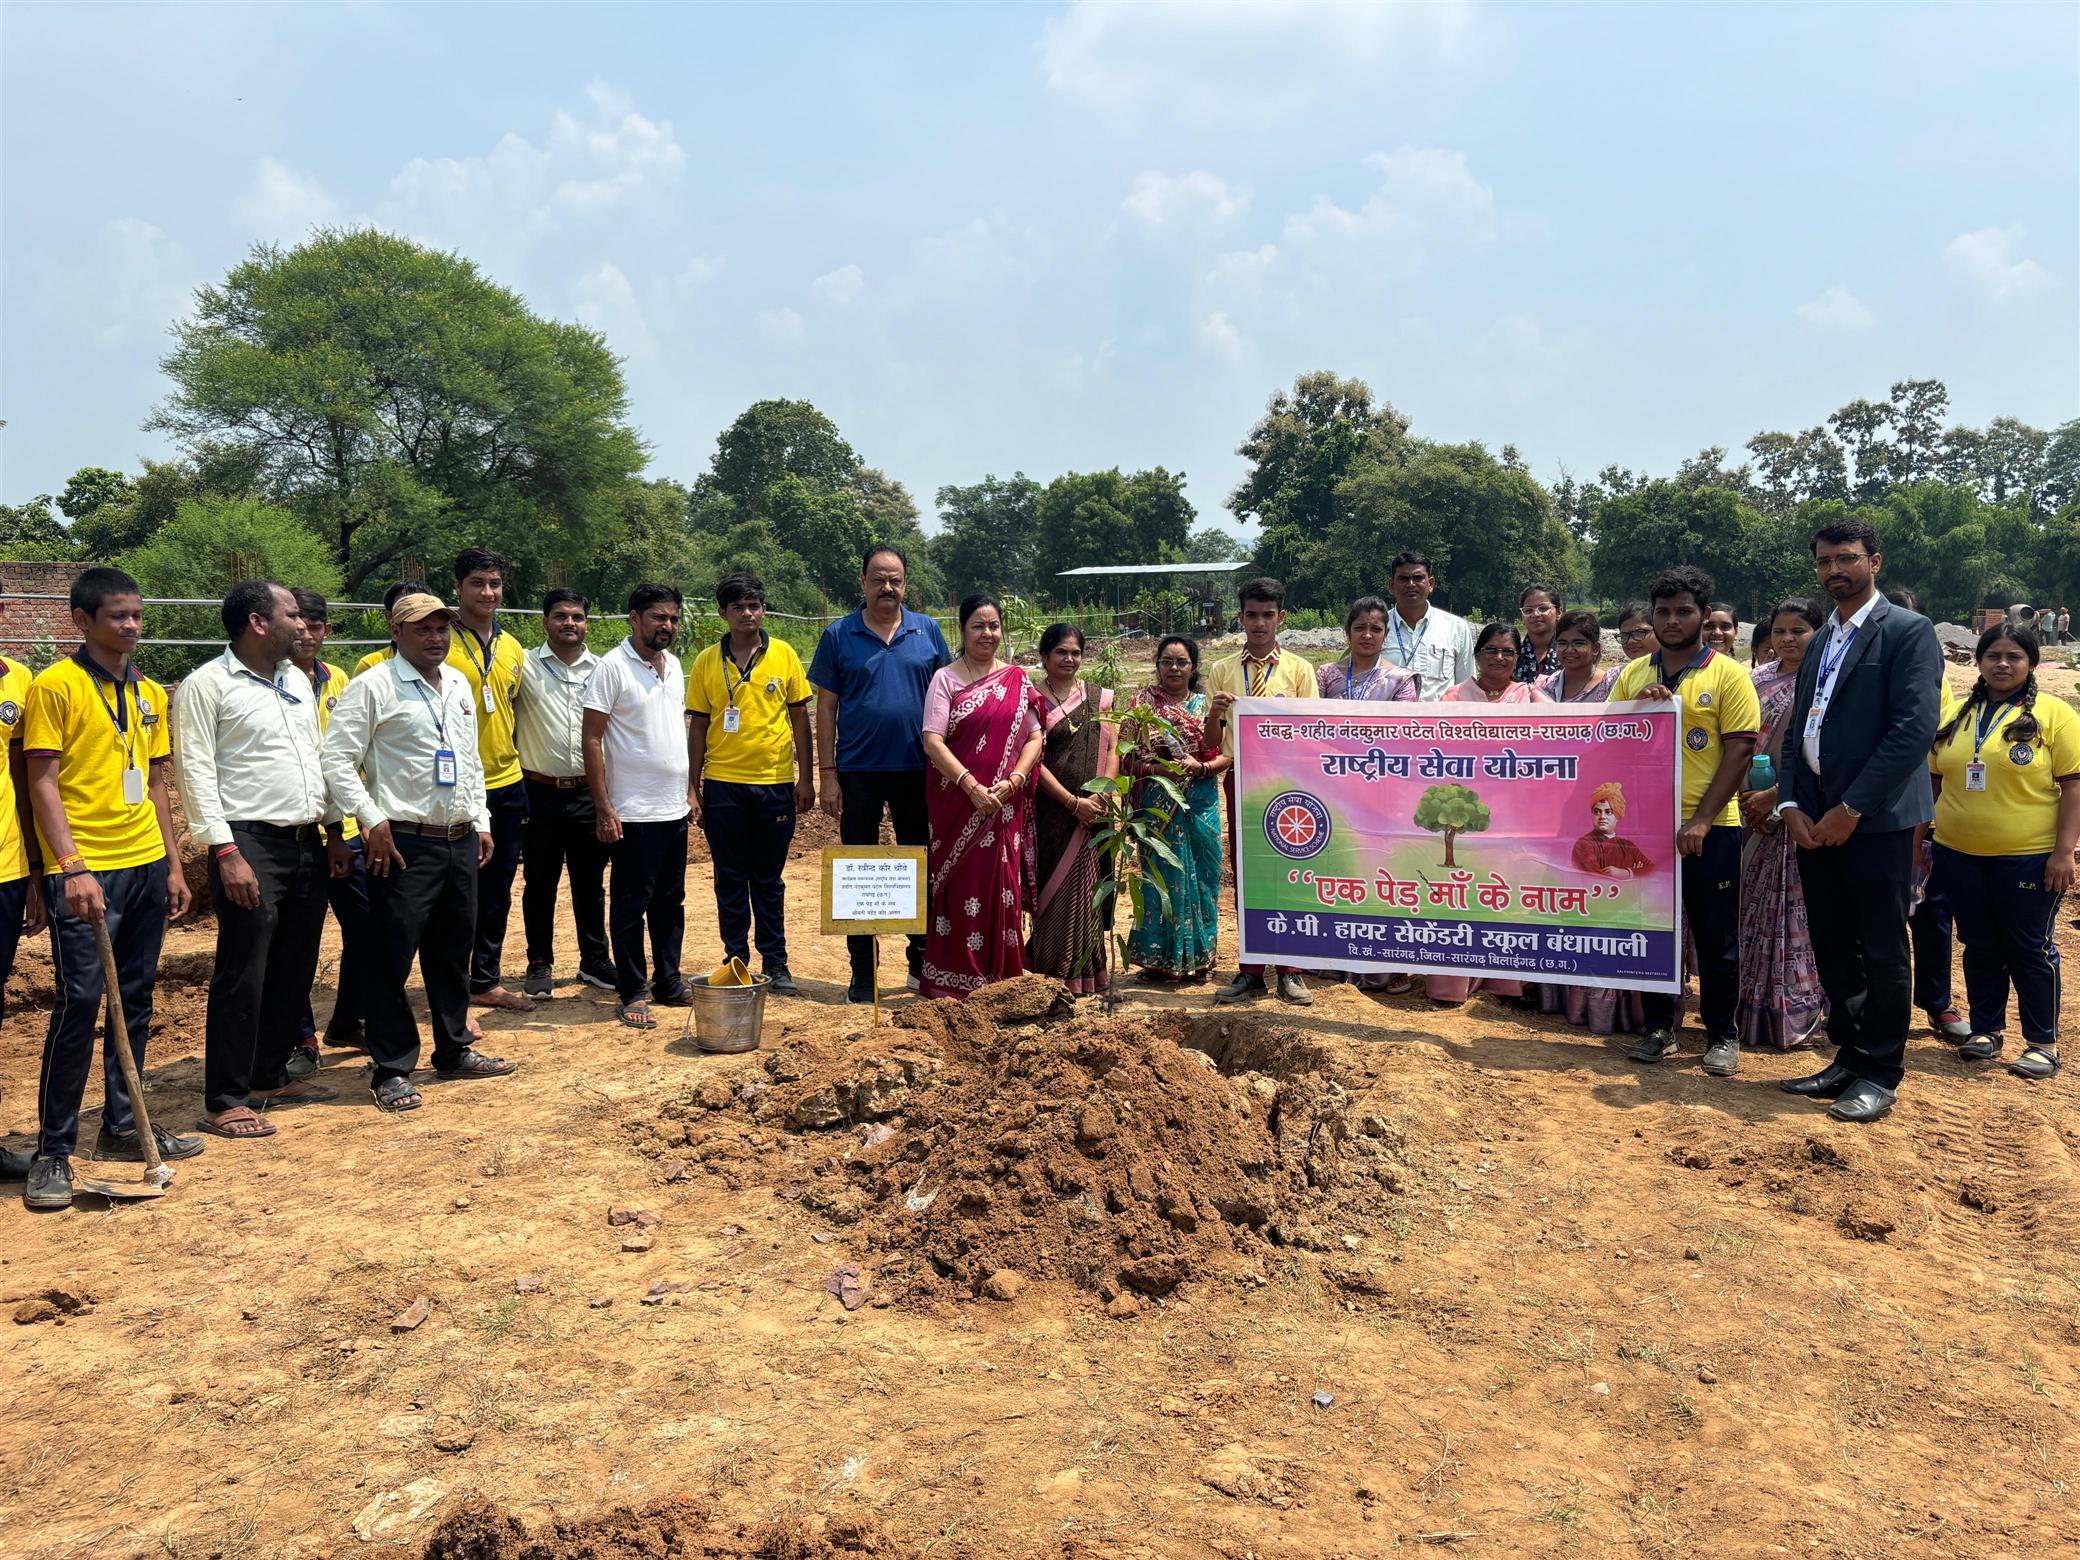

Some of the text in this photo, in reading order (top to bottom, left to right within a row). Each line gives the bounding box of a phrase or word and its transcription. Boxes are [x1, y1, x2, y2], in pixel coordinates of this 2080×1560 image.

[1339, 720, 1399, 743] नंदकुमार
[1402, 720, 1435, 739] पटेल
[1596, 720, 1653, 741] (छ.ग.)
[1320, 748, 1579, 782] राष्ट्रीय सेवा योजना
[1271, 828, 1289, 851] NATIONAL
[1374, 867, 1421, 914] पेड़
[1427, 870, 1470, 911] माँ
[1476, 871, 1512, 911] के
[1334, 920, 1387, 941] हायर
[1393, 919, 1474, 947] सेकेंडरी
[1481, 929, 1539, 954] स्कूल
[1546, 928, 1648, 958] बंधापाली
[1488, 952, 1538, 970] बिलाईगढ़
[1539, 957, 1578, 972] (छ.ग.)
